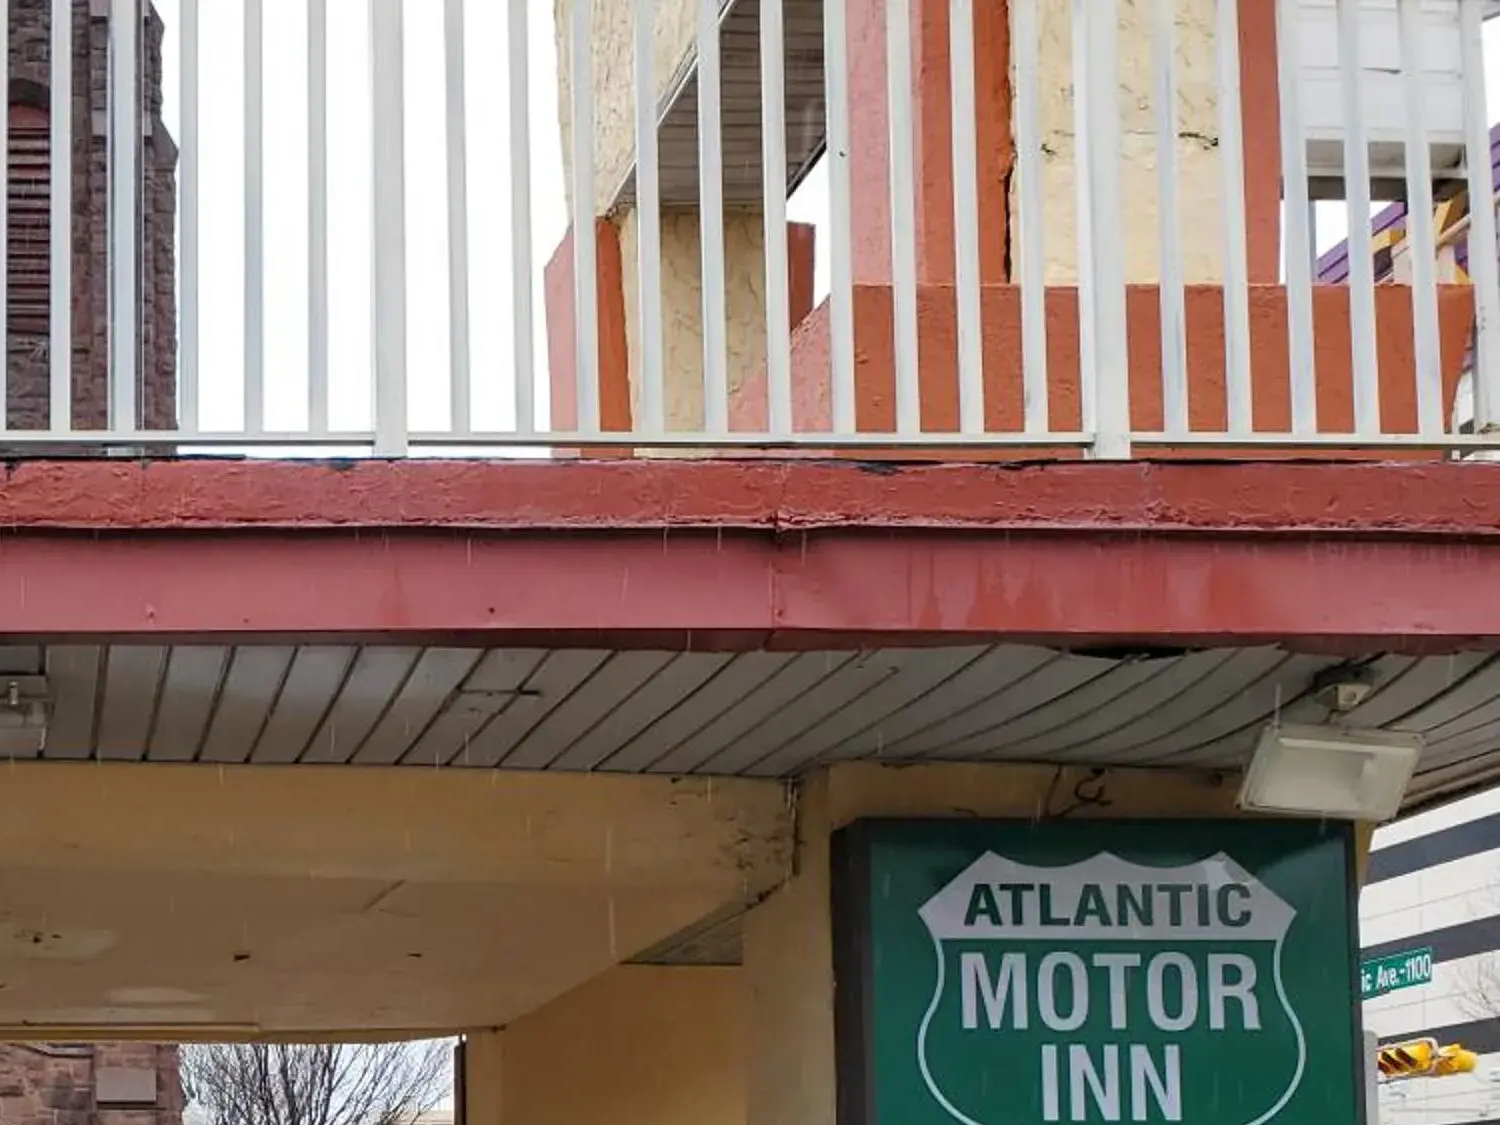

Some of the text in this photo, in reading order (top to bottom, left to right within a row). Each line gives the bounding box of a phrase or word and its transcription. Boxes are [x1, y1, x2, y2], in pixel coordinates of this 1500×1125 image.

[963, 883, 1252, 927] ATLANTIC
[960, 951, 1262, 1031] MOTOR
[1041, 1044, 1183, 1122] INN
